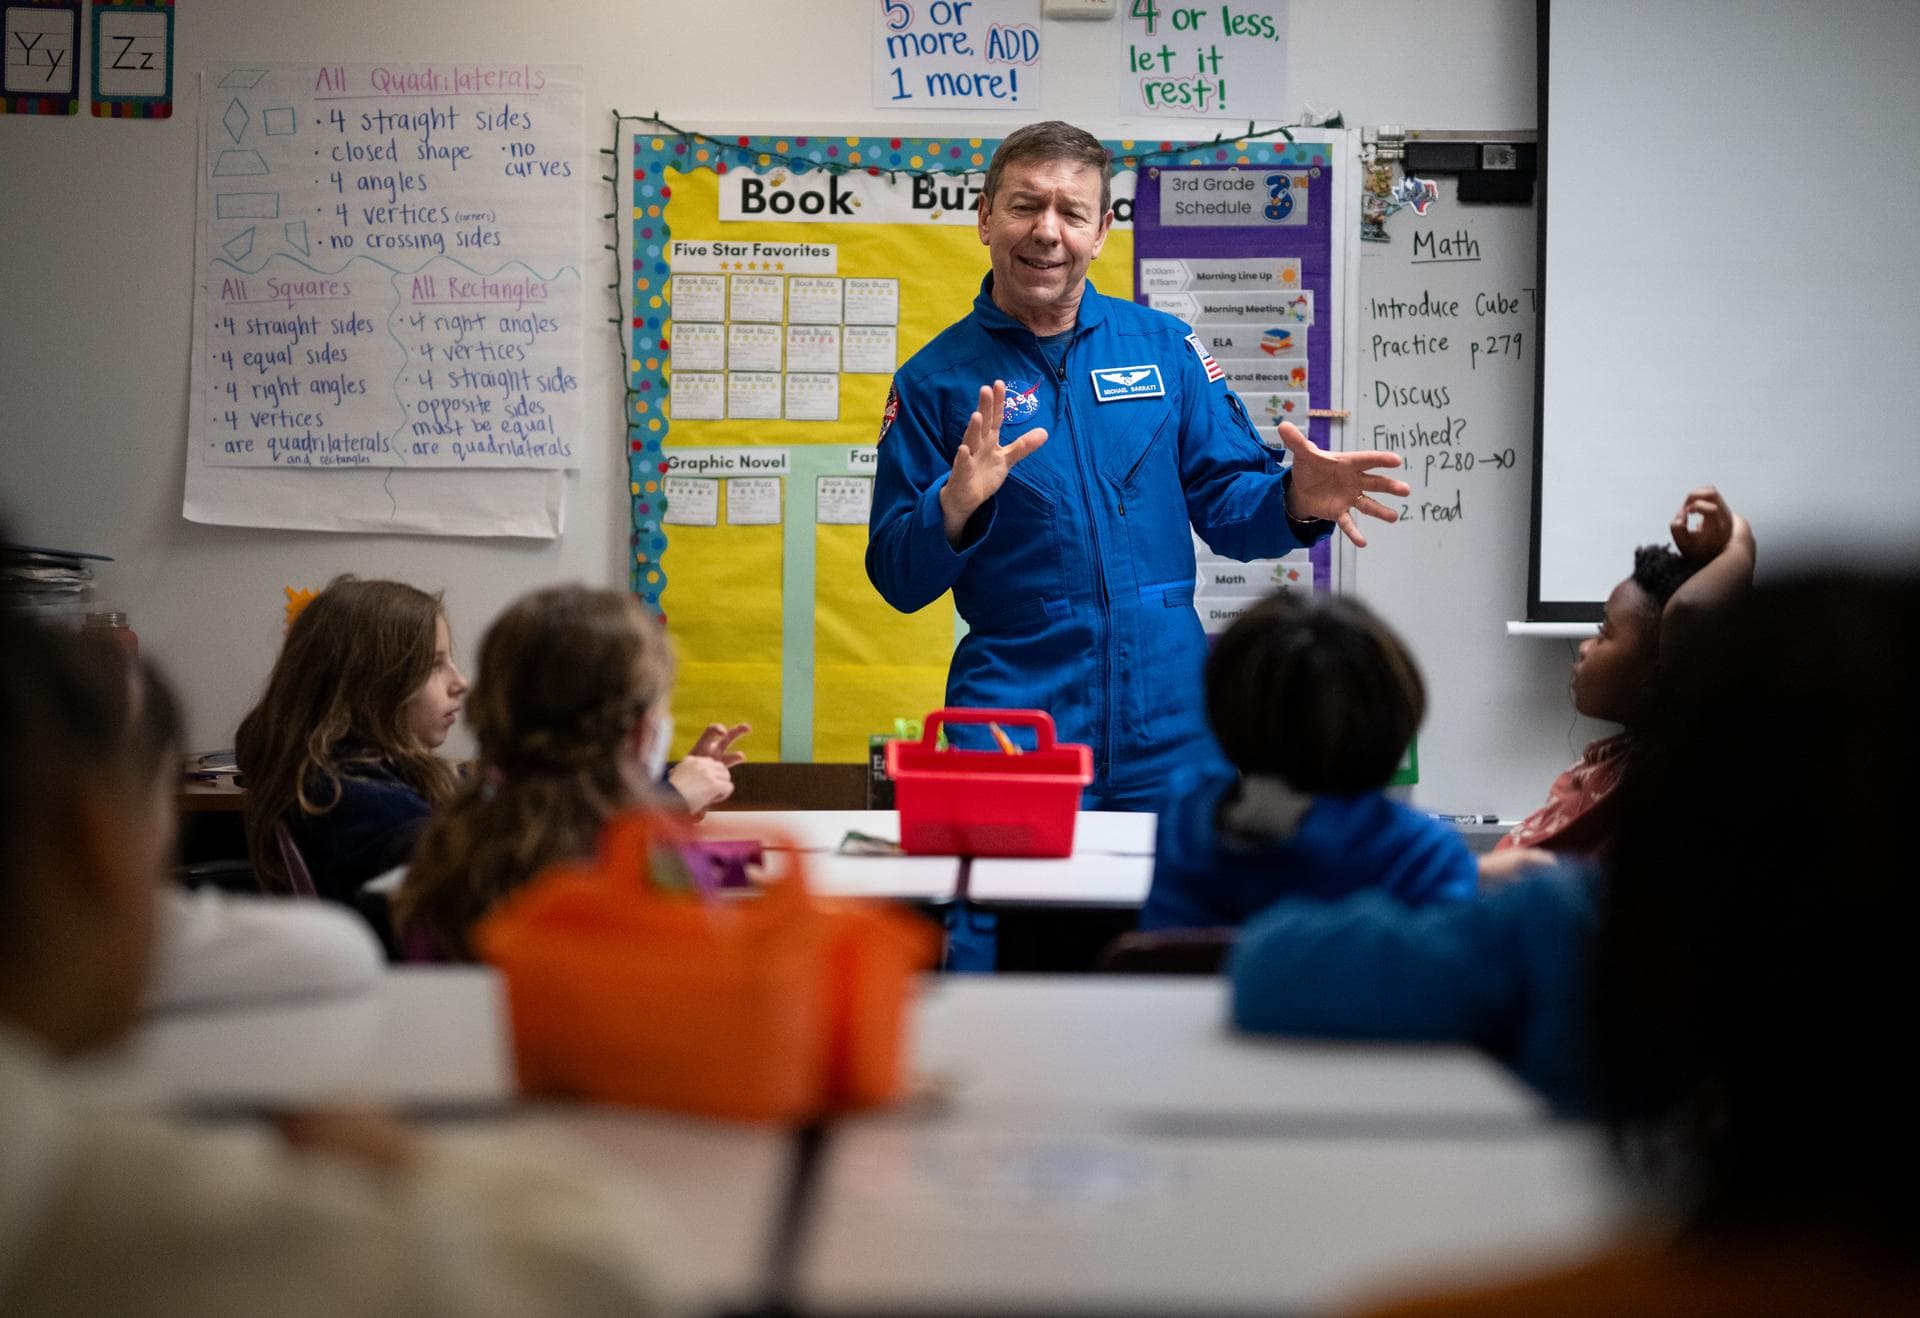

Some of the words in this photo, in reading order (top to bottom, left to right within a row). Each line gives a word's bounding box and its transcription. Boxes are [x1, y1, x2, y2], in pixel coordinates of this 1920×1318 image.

[885, 0, 910, 30] 5
[930, 0, 972, 26] or
[1131, 0, 1161, 35] 4
[1172, 8, 1206, 31] or
[1222, 5, 1280, 42] less,
[14, 32, 65, 82] Yy
[112, 36, 155, 70] Zz
[988, 28, 1040, 62] ADD
[1130, 44, 1177, 73] let
[1197, 45, 1224, 75] it
[315, 67, 346, 92] All
[371, 64, 546, 94] Quadrilaterals
[890, 67, 913, 101] 1
[926, 68, 1018, 102] more!
[1144, 79, 1227, 110] rest!
[329, 110, 345, 133] 4
[361, 107, 460, 141] straight
[476, 104, 532, 130] sides
[332, 139, 398, 163] closed
[416, 140, 472, 171] shape
[510, 143, 536, 158] no
[504, 159, 572, 178] curves
[330, 172, 343, 193] 4
[357, 171, 428, 203] angles
[741, 175, 855, 215] Book
[912, 174, 982, 212] Buz
[1172, 177, 1199, 191] 3rd
[1203, 177, 1255, 191] Grade
[336, 204, 348, 225] 4
[363, 203, 449, 225] vertices
[1175, 200, 1252, 215] Schedule
[330, 234, 353, 249] no
[366, 230, 445, 254] crossing
[456, 228, 501, 247] sides
[674, 242, 707, 257] Five
[712, 242, 748, 257] Star
[752, 242, 830, 258] Favorites
[1412, 229, 1481, 259] Math
[1196, 271, 1237, 283] Morning
[1238, 271, 1258, 280] Line
[1259, 272, 1273, 282] Up
[222, 277, 246, 301] All
[267, 276, 352, 311] Squares
[411, 277, 436, 299] All
[449, 276, 548, 310] Rectangles
[1371, 289, 1460, 320] Introduce
[1475, 291, 1520, 317] Cube
[1204, 304, 1244, 316] Morning
[1245, 304, 1285, 316] Meeting
[223, 317, 235, 336] 4
[246, 312, 320, 345] straight
[331, 311, 374, 334] sides
[410, 312, 425, 332] 4
[434, 311, 487, 342] right
[500, 312, 559, 345] angles
[1213, 338, 1233, 347] ELA
[221, 350, 233, 370] 4
[243, 346, 293, 375] equal
[306, 344, 348, 364] sides
[420, 342, 433, 361] 4
[443, 341, 525, 362] vertices
[1372, 333, 1449, 362] Practice
[226, 382, 238, 401] 4
[252, 377, 302, 408] right
[310, 376, 367, 406] angles
[418, 370, 432, 390] 4
[448, 368, 531, 400] straight
[537, 366, 578, 393] sides
[1375, 380, 1451, 409] Discuss
[224, 406, 237, 425] 4
[250, 408, 324, 428] vertices
[417, 396, 491, 425] opposite
[504, 396, 545, 418] sides
[411, 420, 463, 435] must
[472, 419, 491, 434] be
[501, 415, 555, 441] equal
[1373, 415, 1467, 451] Finished?
[224, 437, 254, 454] are
[267, 433, 390, 461] quadrilaterals
[287, 453, 312, 466] and
[320, 453, 371, 466] rectangles
[412, 440, 440, 456] are
[453, 438, 571, 461] quadrilaterals
[668, 454, 734, 473] Graphic
[740, 453, 786, 469] Novel
[1421, 488, 1463, 522] read
[1215, 574, 1246, 584] Math
